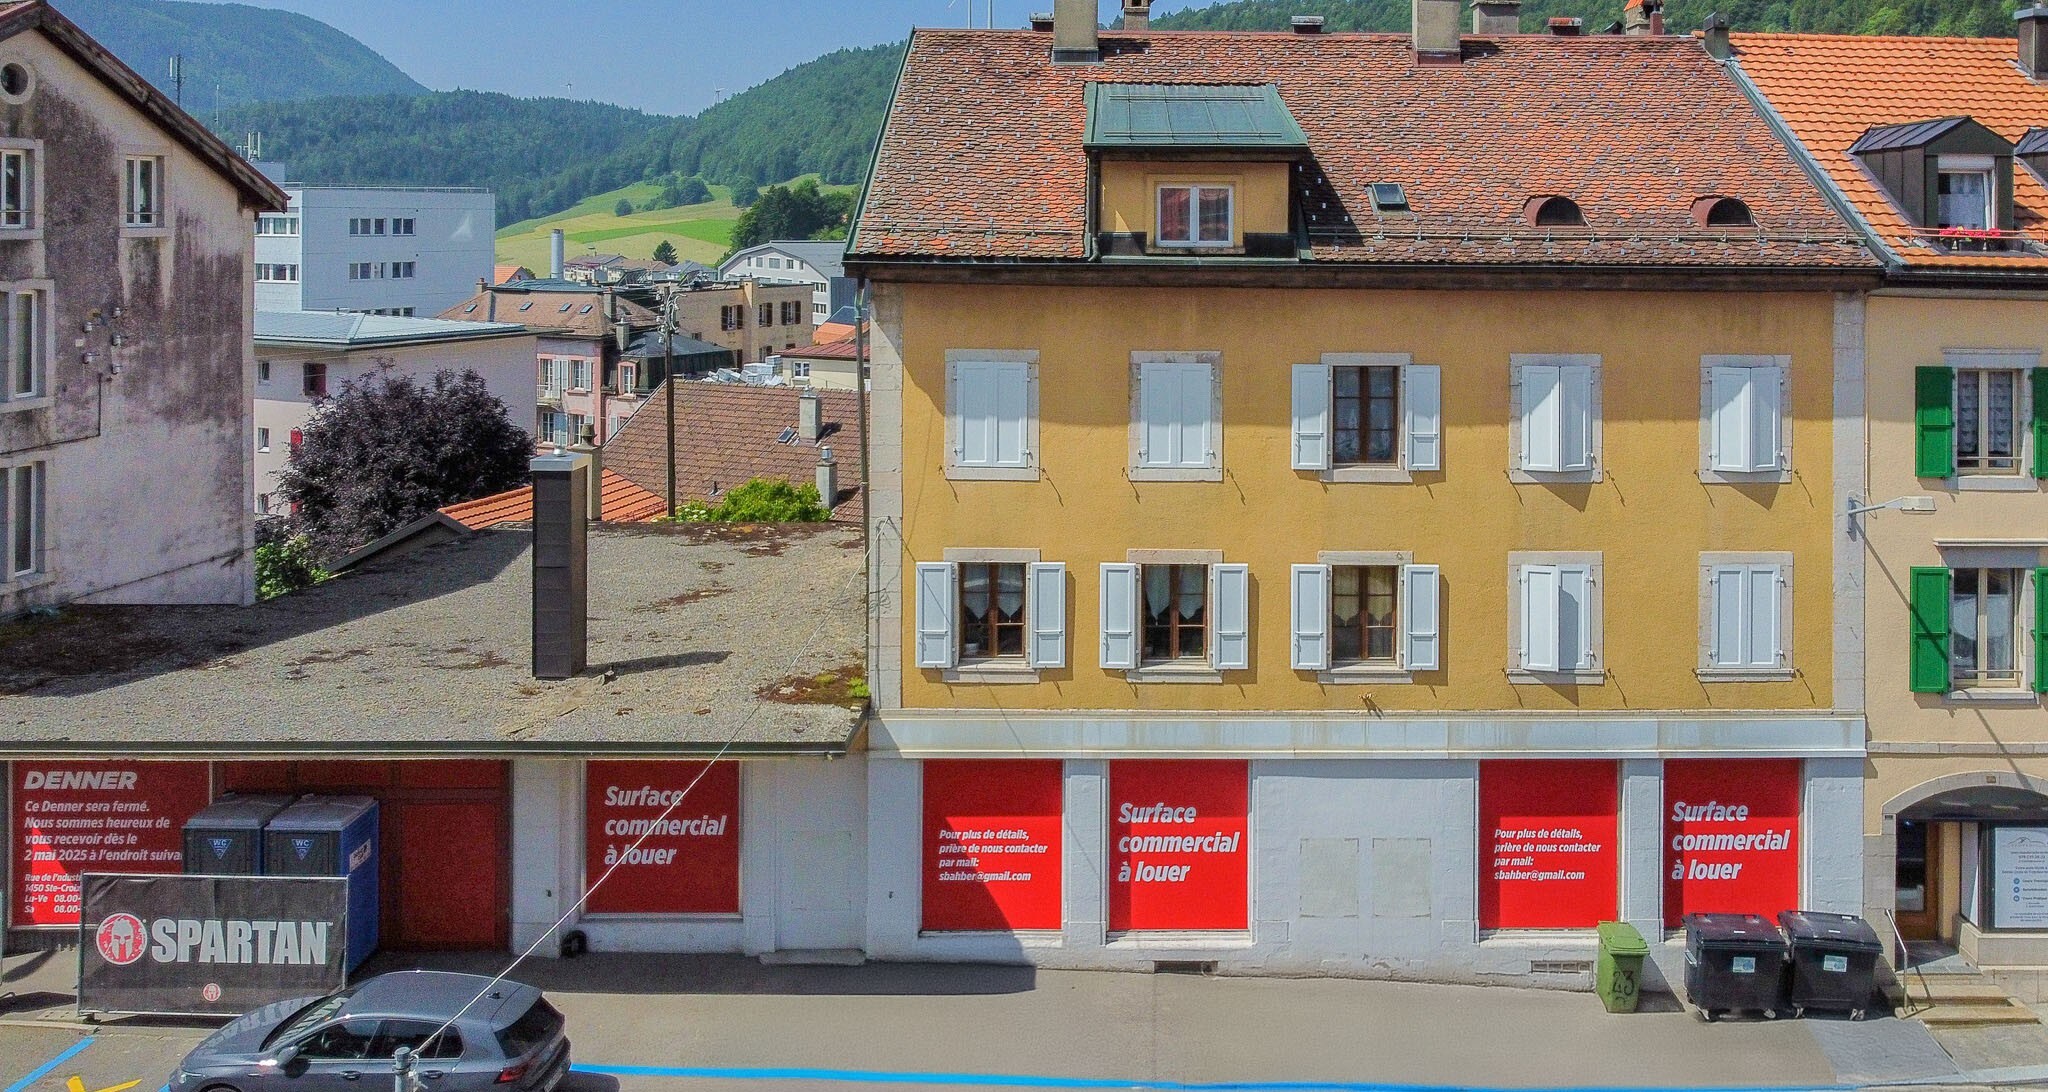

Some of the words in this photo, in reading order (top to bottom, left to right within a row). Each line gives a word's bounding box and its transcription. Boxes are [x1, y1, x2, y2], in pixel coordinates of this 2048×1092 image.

[24, 771, 138, 790] DENNER
[605, 786, 684, 807] Surface
[25, 801, 39, 812] Ce
[41, 801, 83, 812] Denner
[85, 803, 110, 812] sera
[112, 800, 150, 812] fermé.
[1671, 801, 1749, 822] Surface
[1118, 802, 1197, 823] Surface
[24, 817, 56, 829] Nous
[56, 819, 103, 829] sommes
[106, 817, 152, 829] heureux
[155, 817, 170, 829] de
[605, 815, 728, 836] commercial
[25, 835, 52, 845] vous
[54, 833, 102, 845] recevoir
[104, 833, 124, 845] dès
[126, 833, 138, 845] le
[939, 830, 961, 839] Pour
[962, 830, 982, 840] plus
[983, 830, 995, 839] de
[996, 829, 1030, 841] détails,
[1494, 829, 1516, 839] Pour
[1517, 829, 1536, 839] plus
[1537, 829, 1549, 839] de
[1550, 828, 1583, 840] détails,
[1672, 829, 1791, 851] commercial
[213, 839, 227, 847] WC
[297, 839, 311, 847] WC
[1119, 831, 1240, 853] commercial
[1494, 842, 1521, 853] prière
[1523, 842, 1534, 852] de
[1535, 844, 1557, 852] nous
[1558, 843, 1601, 852] contacter
[24, 850, 32, 861] 2
[33, 850, 56, 861] mai
[58, 850, 86, 861] 2025
[89, 850, 97, 861] à
[99, 849, 147, 861] l'endroit
[150, 850, 183, 861] suiva
[604, 845, 618, 865] à
[621, 845, 677, 865] louer
[939, 844, 967, 854] prière
[968, 844, 979, 853] de
[981, 845, 1004, 853] nous
[1004, 844, 1048, 853] contacter
[939, 859, 955, 868] par
[956, 857, 979, 867] mail:
[1494, 858, 1510, 867] par
[1510, 856, 1534, 866] mail:
[1118, 861, 1131, 882] à
[1135, 861, 1191, 882] louer
[1494, 870, 1585, 881] sbahber@gmail.com
[1671, 859, 1685, 880] à
[1687, 859, 1743, 880] louer
[24, 873, 40, 882] Rue
[41, 873, 52, 882] de
[939, 871, 1031, 882] sbahber@gmail.com
